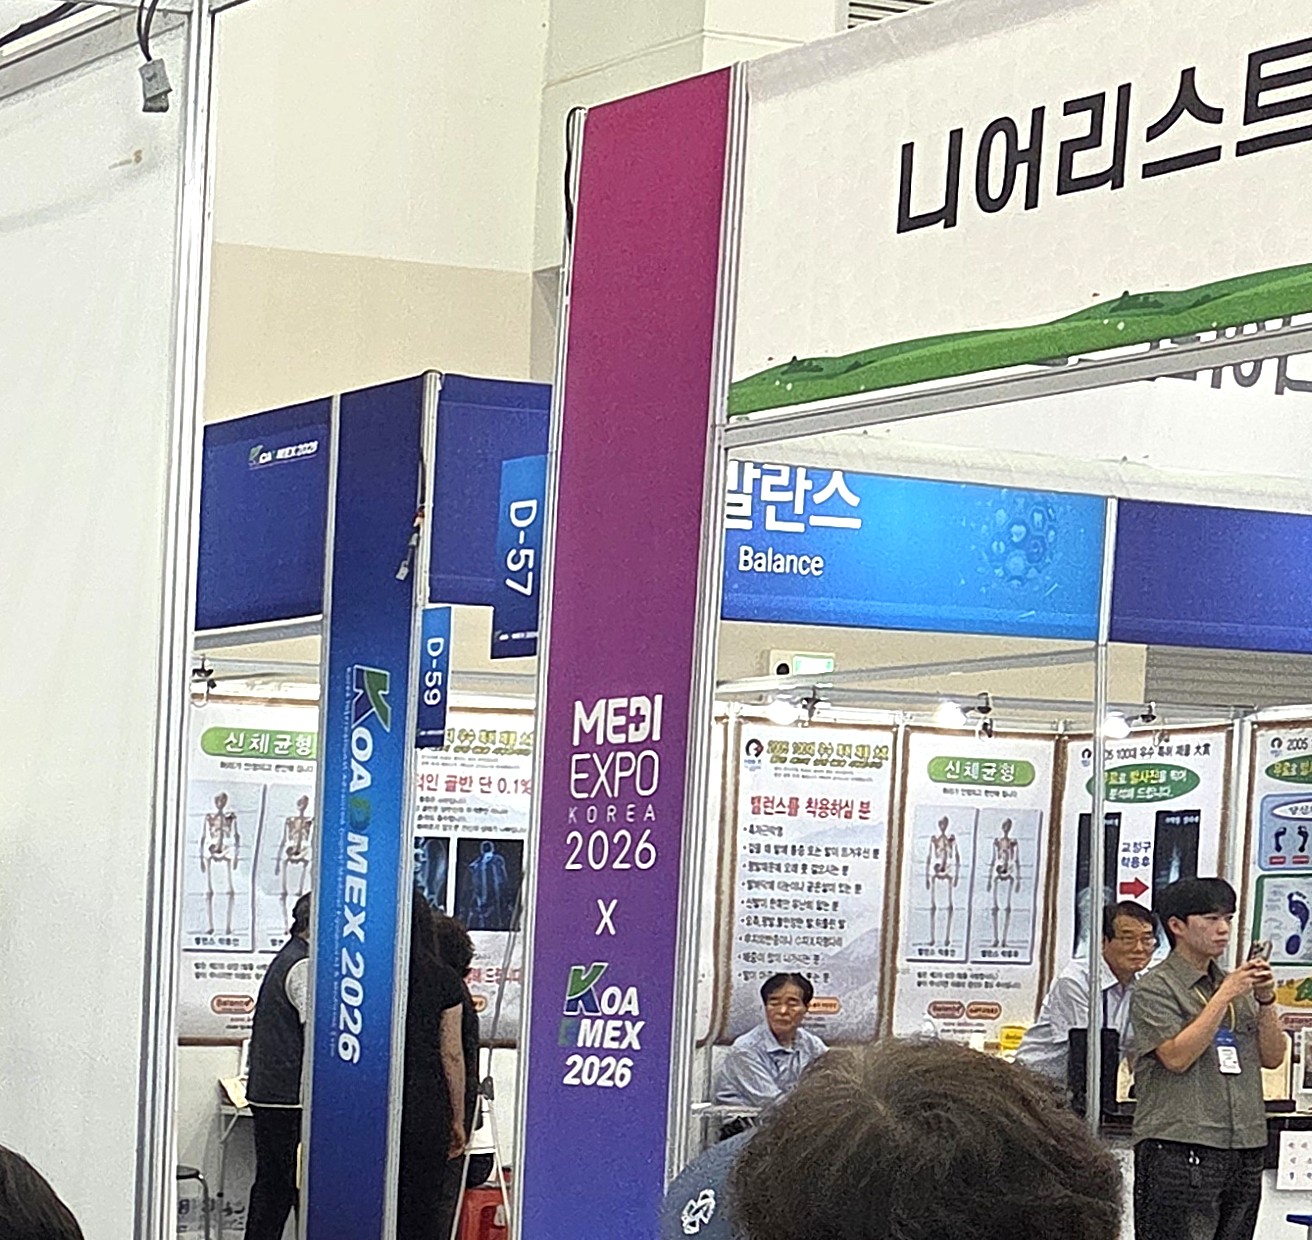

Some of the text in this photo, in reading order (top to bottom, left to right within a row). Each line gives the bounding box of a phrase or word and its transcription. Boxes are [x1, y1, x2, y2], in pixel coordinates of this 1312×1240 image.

[505, 498, 539, 597] D-57
[738, 545, 825, 577] Balance
[422, 636, 444, 707] D-59
[572, 694, 663, 746] MEDI
[224, 732, 311, 756] 신체균형
[569, 749, 660, 799] EXPO
[944, 760, 1015, 783] 신체균형
[567, 803, 656, 824] KOREA
[564, 829, 657, 871] 2026
[595, 898, 617, 936] X
[337, 946, 366, 1065] 2026
[564, 962, 640, 1017] KOA
[563, 1055, 634, 1088] 2026
